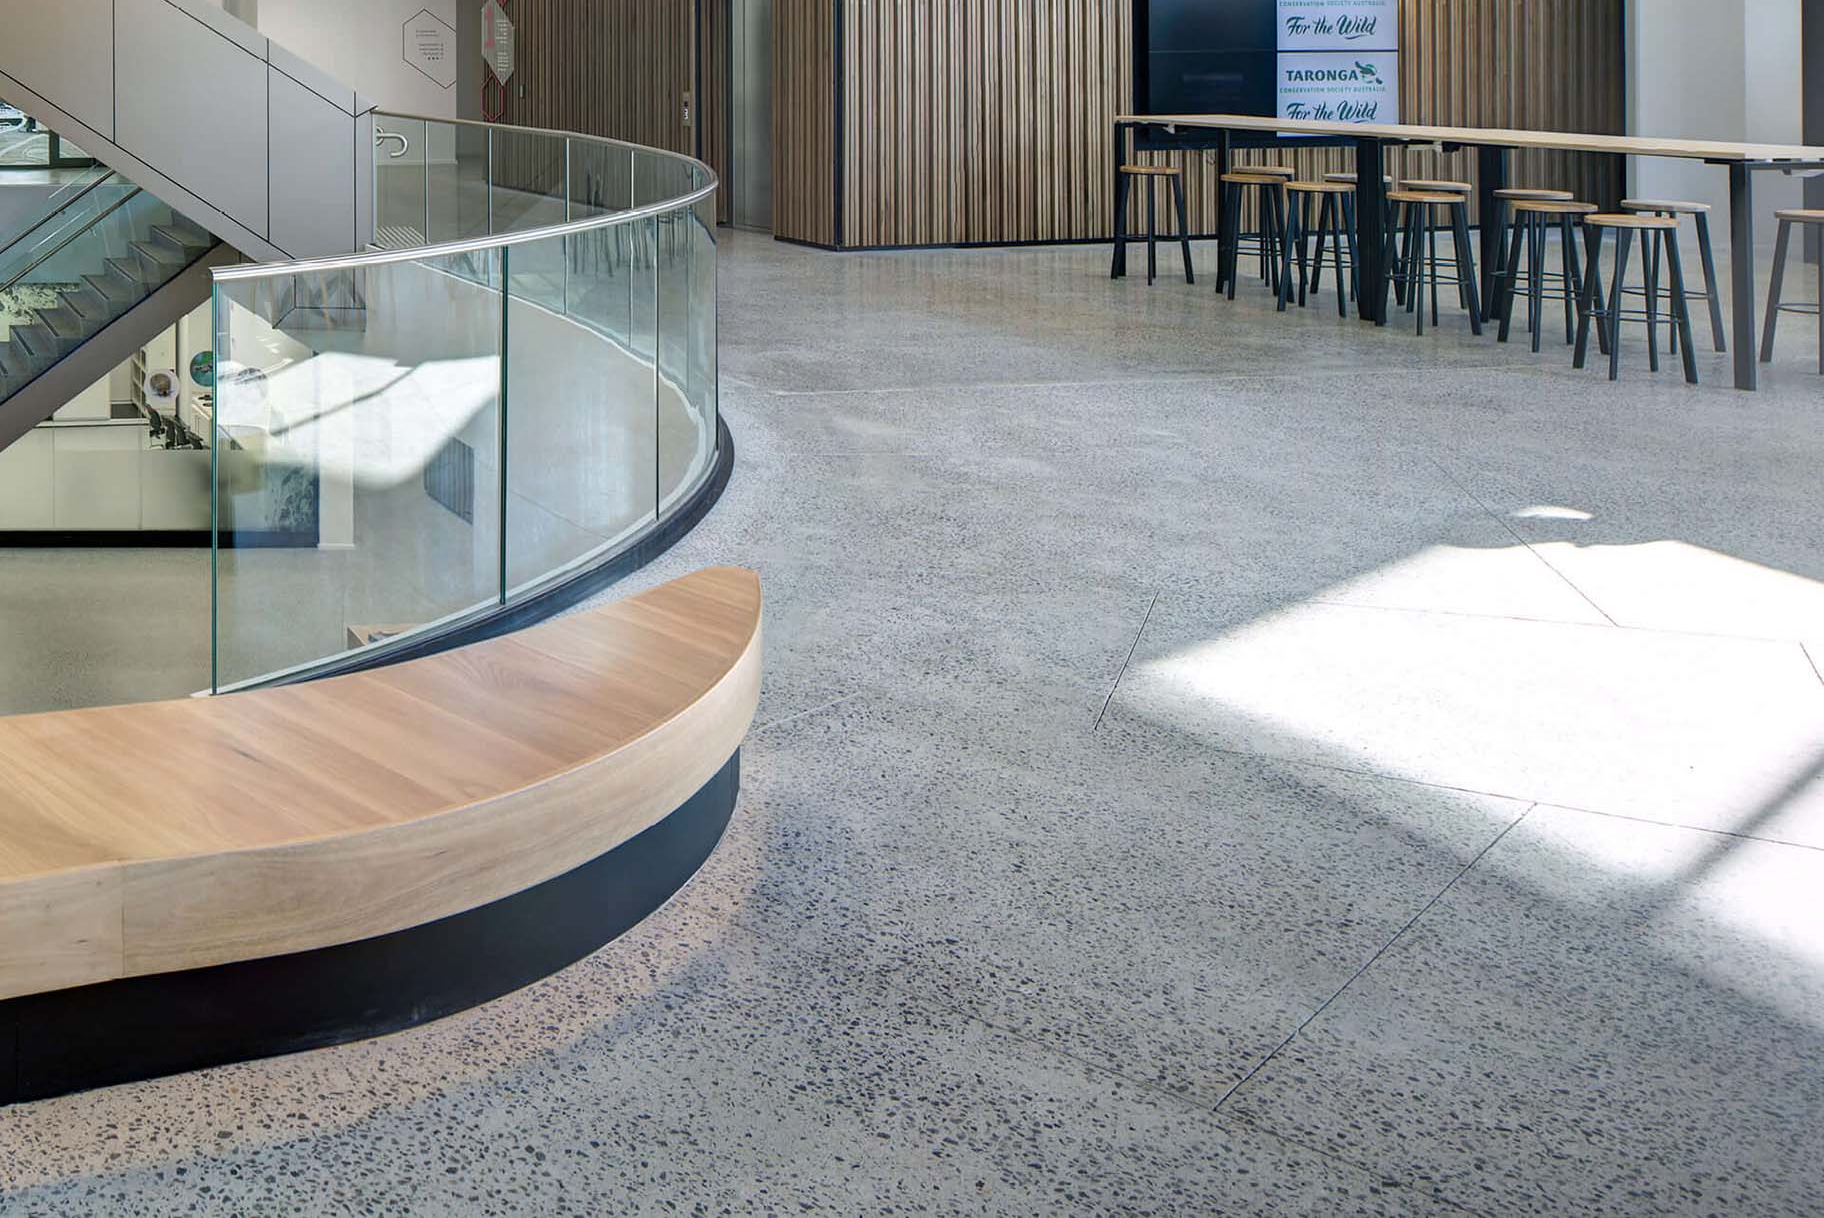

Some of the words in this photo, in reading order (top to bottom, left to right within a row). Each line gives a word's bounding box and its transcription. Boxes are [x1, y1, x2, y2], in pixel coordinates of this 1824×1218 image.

[1286, 16, 1311, 37] For
[1311, 15, 1333, 35] the
[1336, 14, 1377, 39] Wild
[1286, 69, 1359, 82] TARONGA
[1286, 102, 1311, 120] For
[1311, 101, 1334, 120] the
[1337, 100, 1378, 123] Wild
